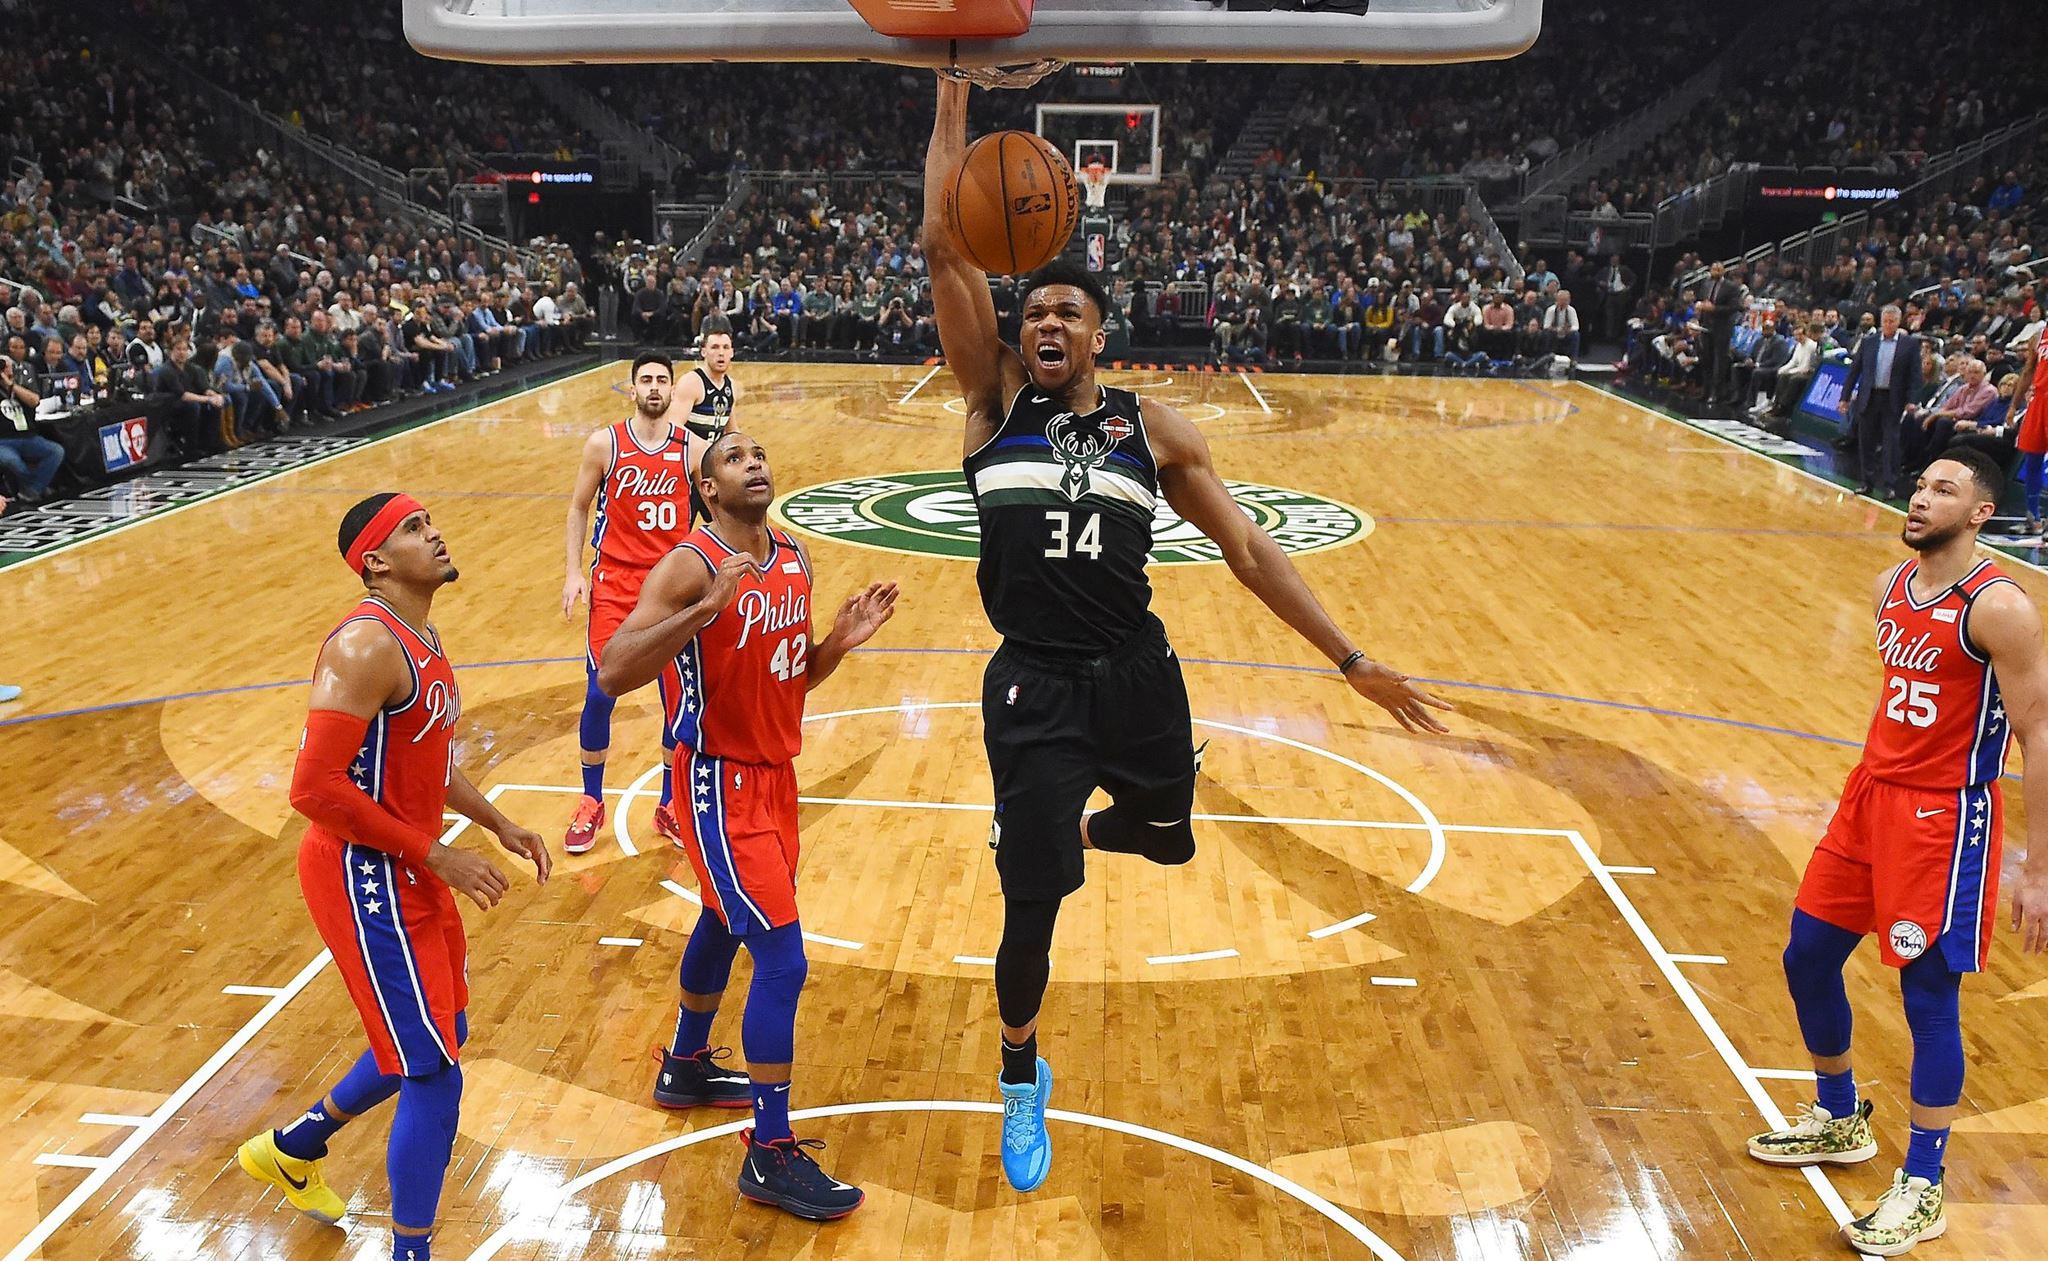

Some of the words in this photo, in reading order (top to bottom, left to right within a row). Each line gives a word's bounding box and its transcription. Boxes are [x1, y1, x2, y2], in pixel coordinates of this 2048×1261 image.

[1089, 66, 1125, 76] TISSOT
[1836, 187, 1849, 199] the
[1850, 188, 1876, 200] speed
[1876, 188, 1886, 199] of
[615, 465, 678, 499] Phila
[797, 479, 914, 501] EST.
[637, 501, 677, 531] 30
[786, 503, 884, 534] 1968
[1044, 511, 1103, 560] 34
[737, 585, 807, 650] Phila
[770, 632, 807, 682] 42
[1876, 619, 1942, 672] Phila
[411, 680, 461, 743] Phil
[1886, 675, 1940, 728] 25
